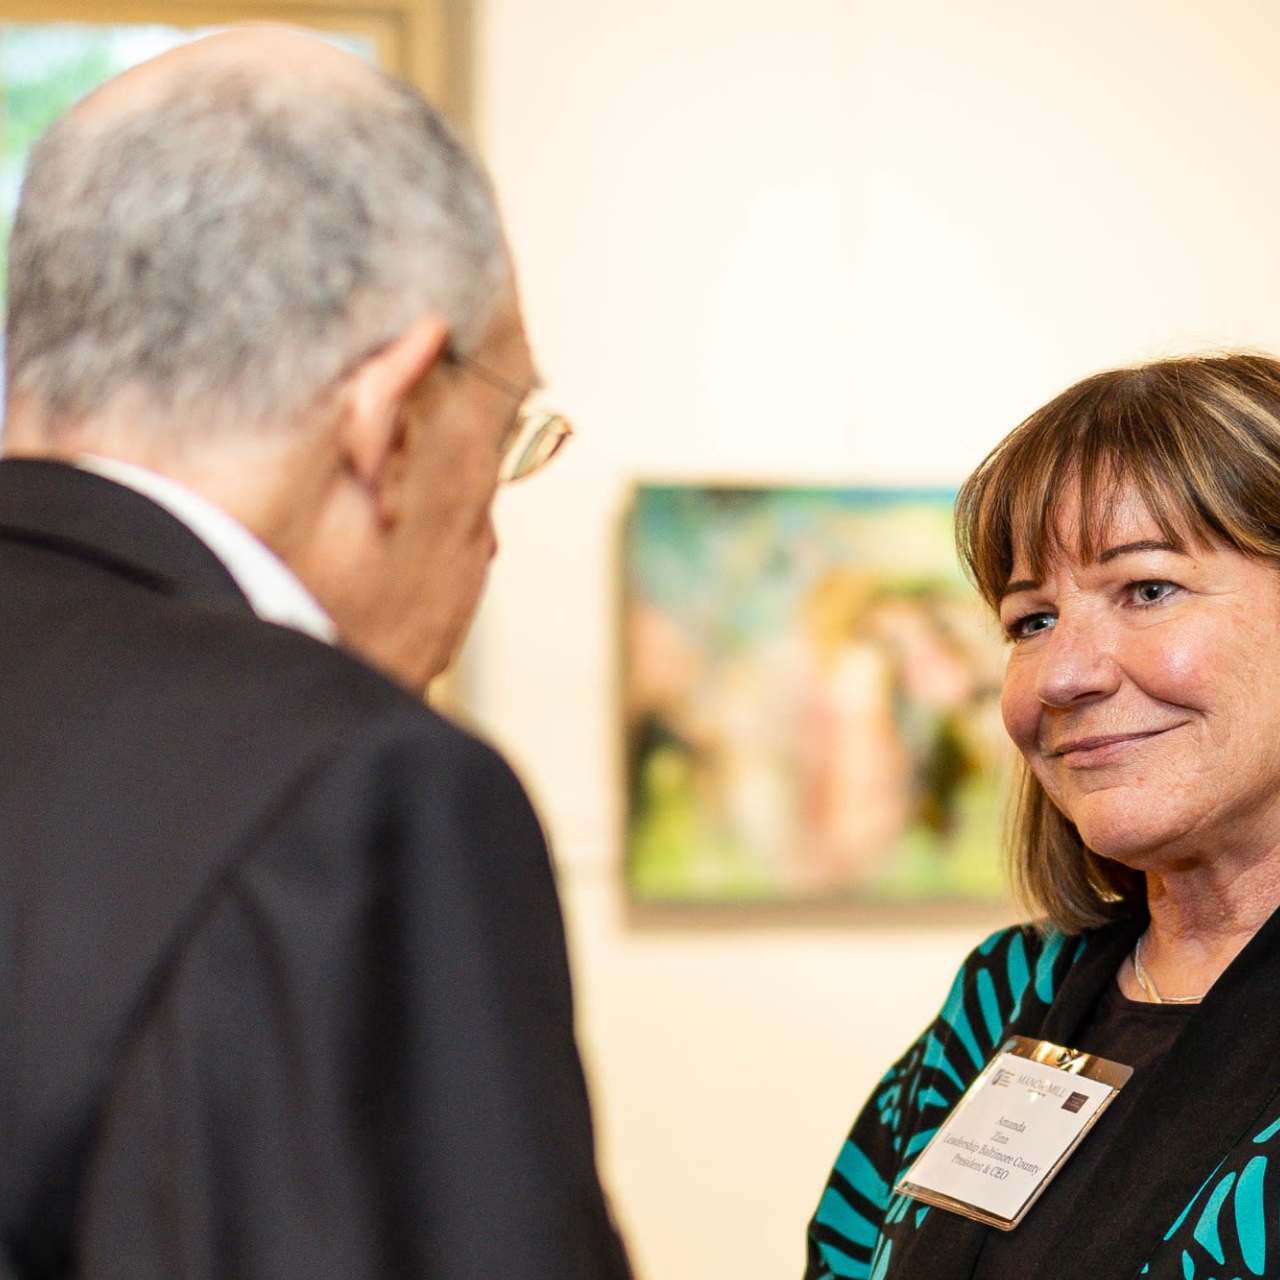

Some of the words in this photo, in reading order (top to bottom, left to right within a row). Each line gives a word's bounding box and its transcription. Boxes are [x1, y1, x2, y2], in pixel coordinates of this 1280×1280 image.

[944, 1134, 980, 1154] Leadership
[978, 1144, 1014, 1165] Baltimore
[1013, 1156, 1040, 1175] County
[951, 1153, 984, 1172] President
[989, 1166, 1010, 1180] CEO
